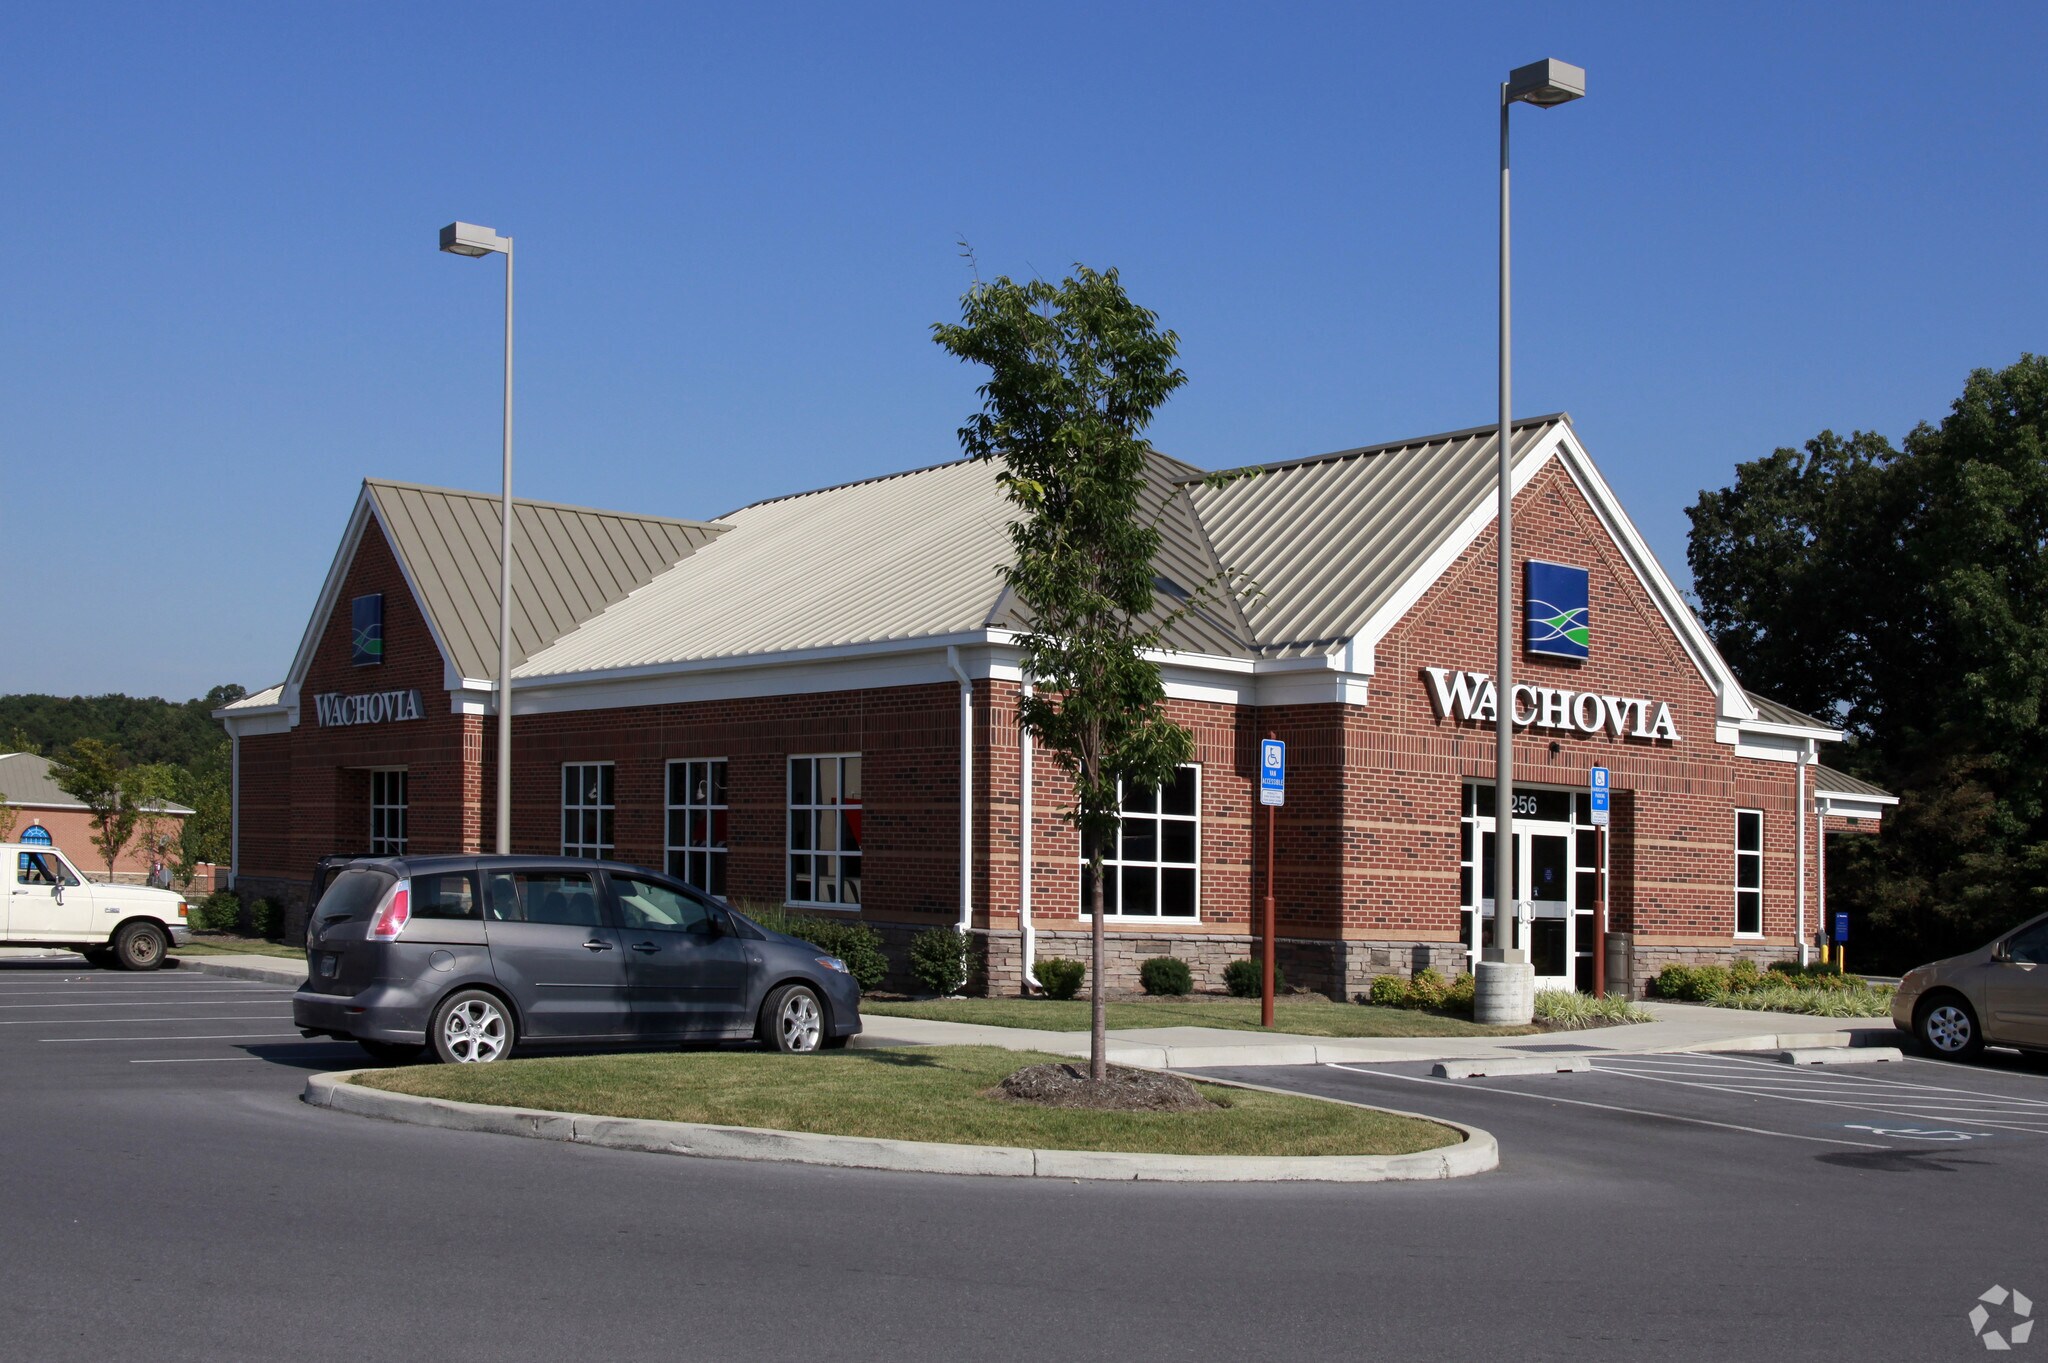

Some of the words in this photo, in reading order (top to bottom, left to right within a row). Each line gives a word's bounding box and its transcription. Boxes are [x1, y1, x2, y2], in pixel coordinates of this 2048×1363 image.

[313, 688, 421, 728] WACHOVIA
[1425, 666, 1682, 741] WACHOVIA
[1262, 777, 1283, 786] ACCESSIBLE
[1511, 794, 1538, 815] 256
